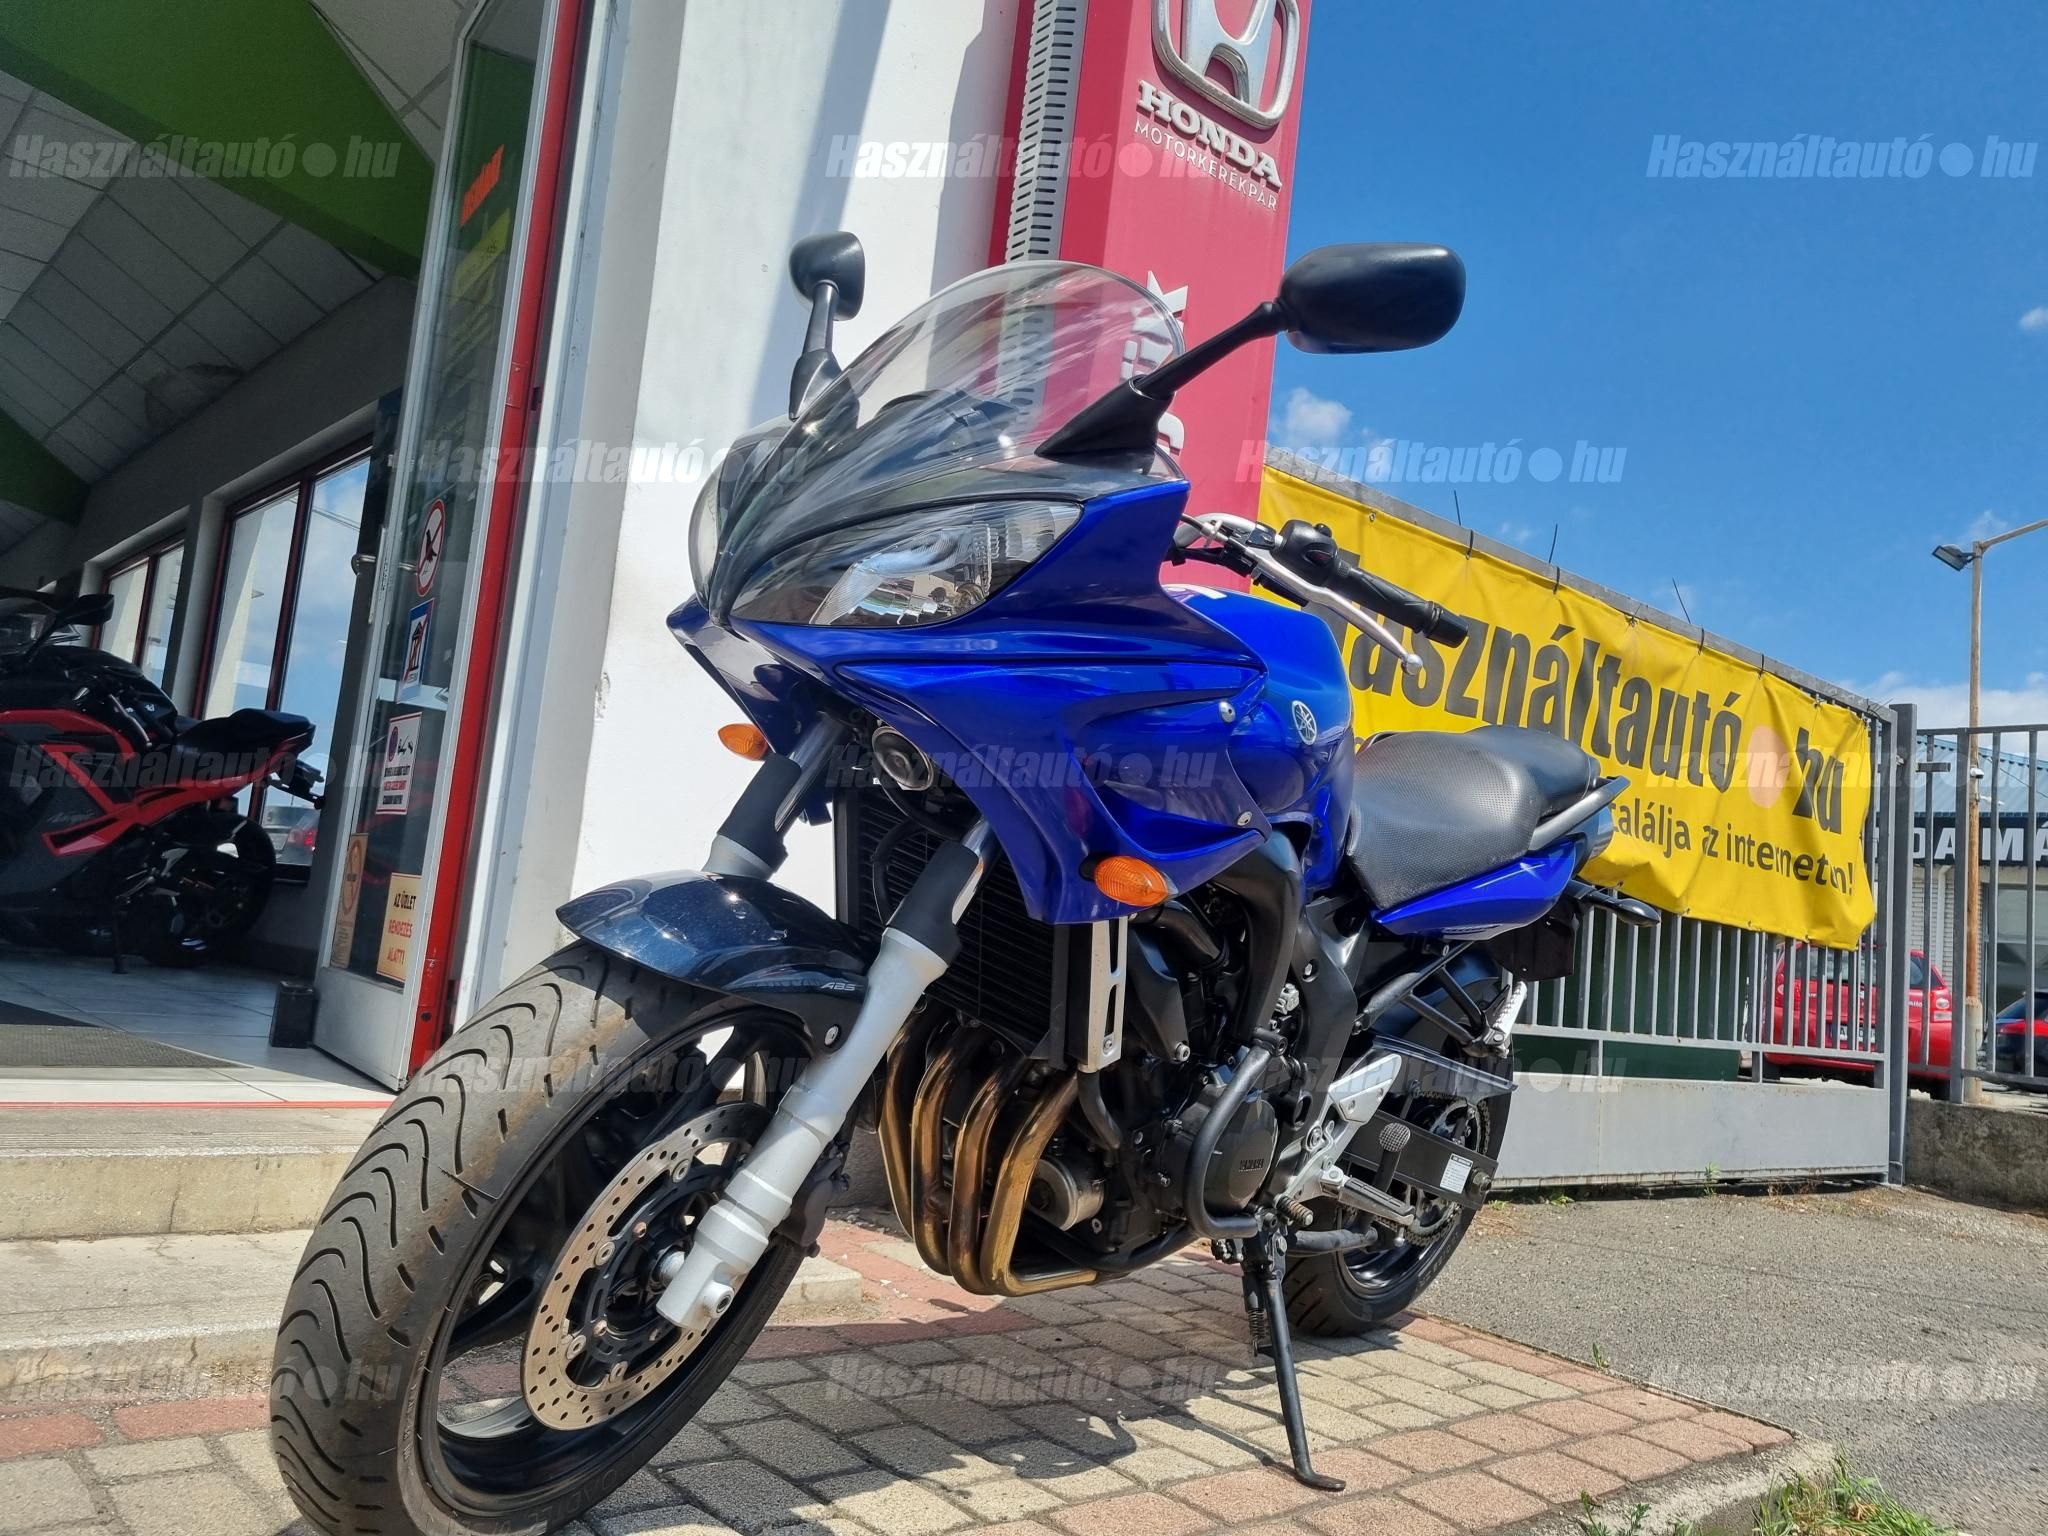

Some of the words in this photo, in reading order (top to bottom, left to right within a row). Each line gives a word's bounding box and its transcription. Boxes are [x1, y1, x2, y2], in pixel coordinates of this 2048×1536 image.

[1134, 117, 1278, 211] MOTORKERÉKPÁR
[1135, 79, 1283, 190] HONDA
[820, 981, 858, 992] ABS
